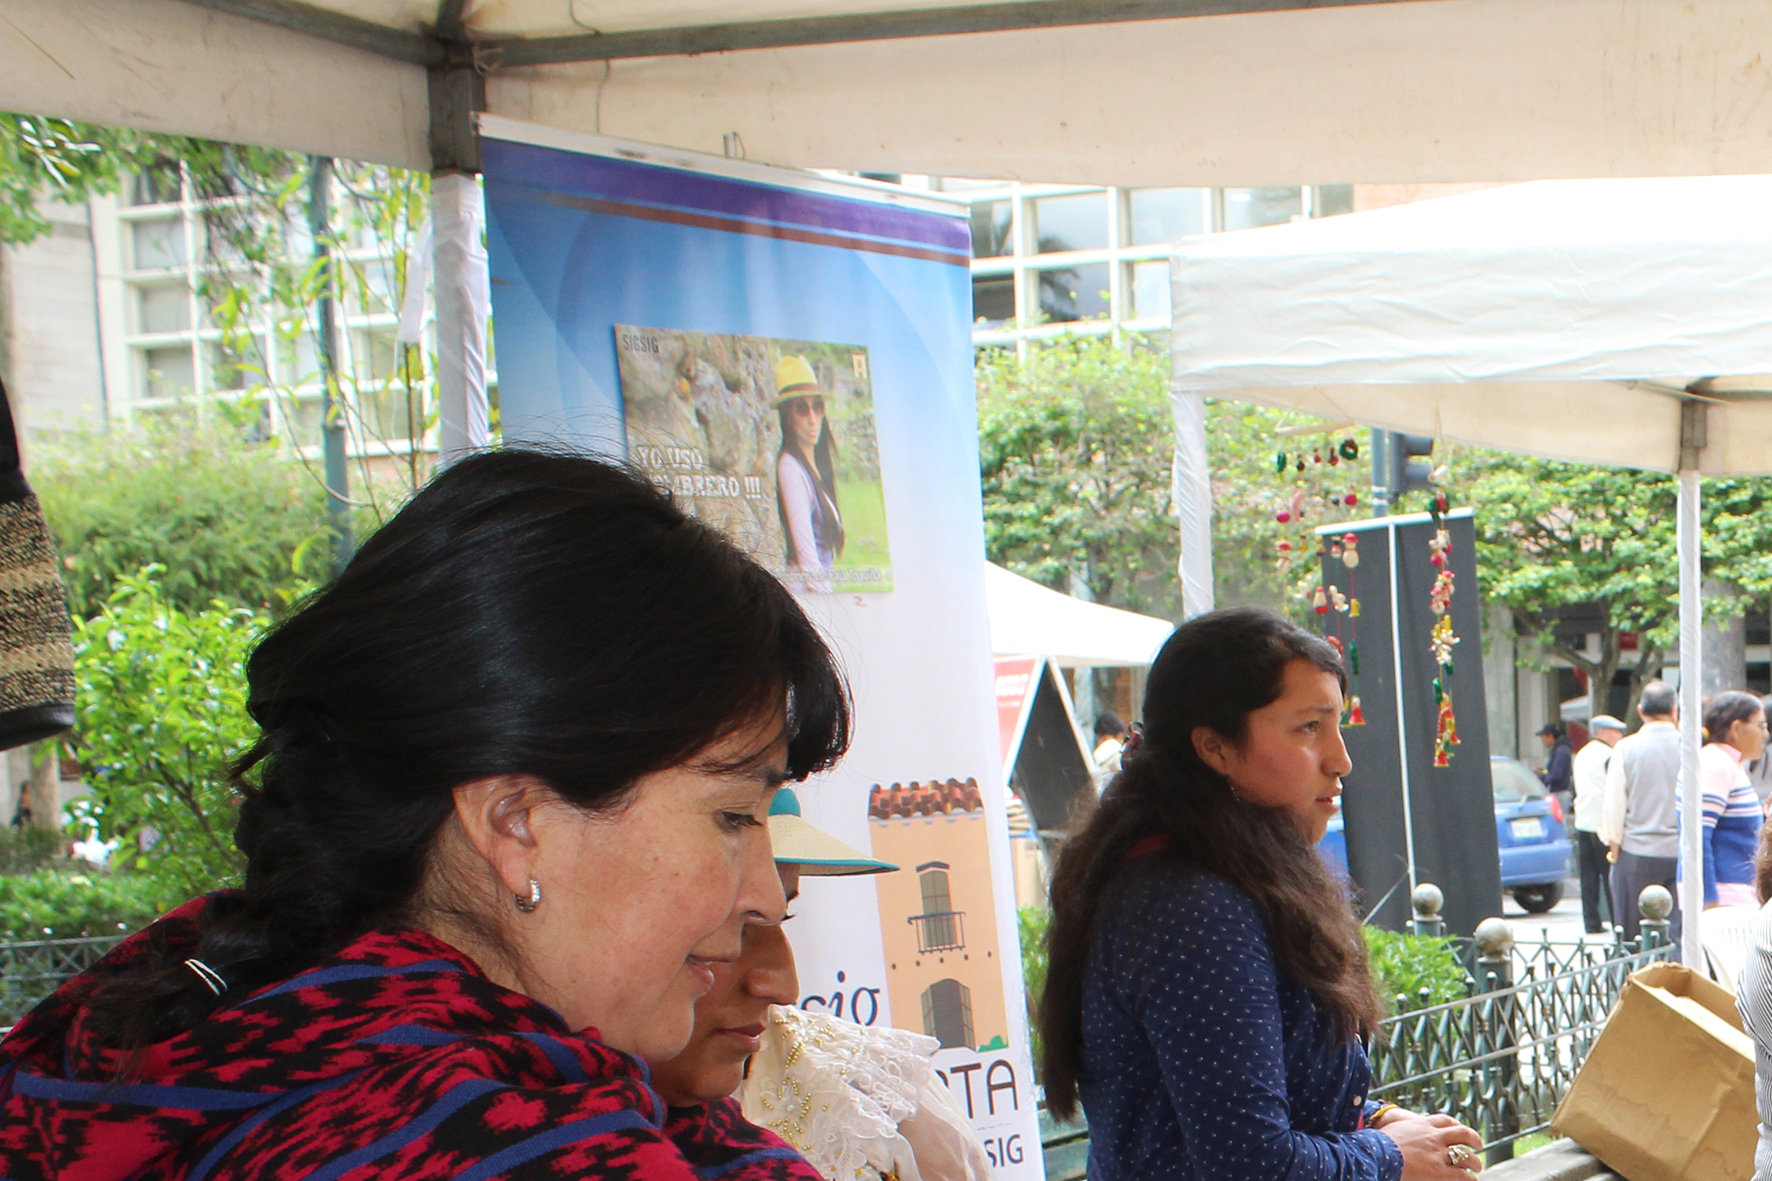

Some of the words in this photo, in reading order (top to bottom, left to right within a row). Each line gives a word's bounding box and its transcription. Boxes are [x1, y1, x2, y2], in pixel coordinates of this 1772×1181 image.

[621, 332, 660, 355] SIGSIG
[636, 446, 662, 469] YO
[666, 446, 704, 471] USO
[935, 1059, 1018, 1119] TA
